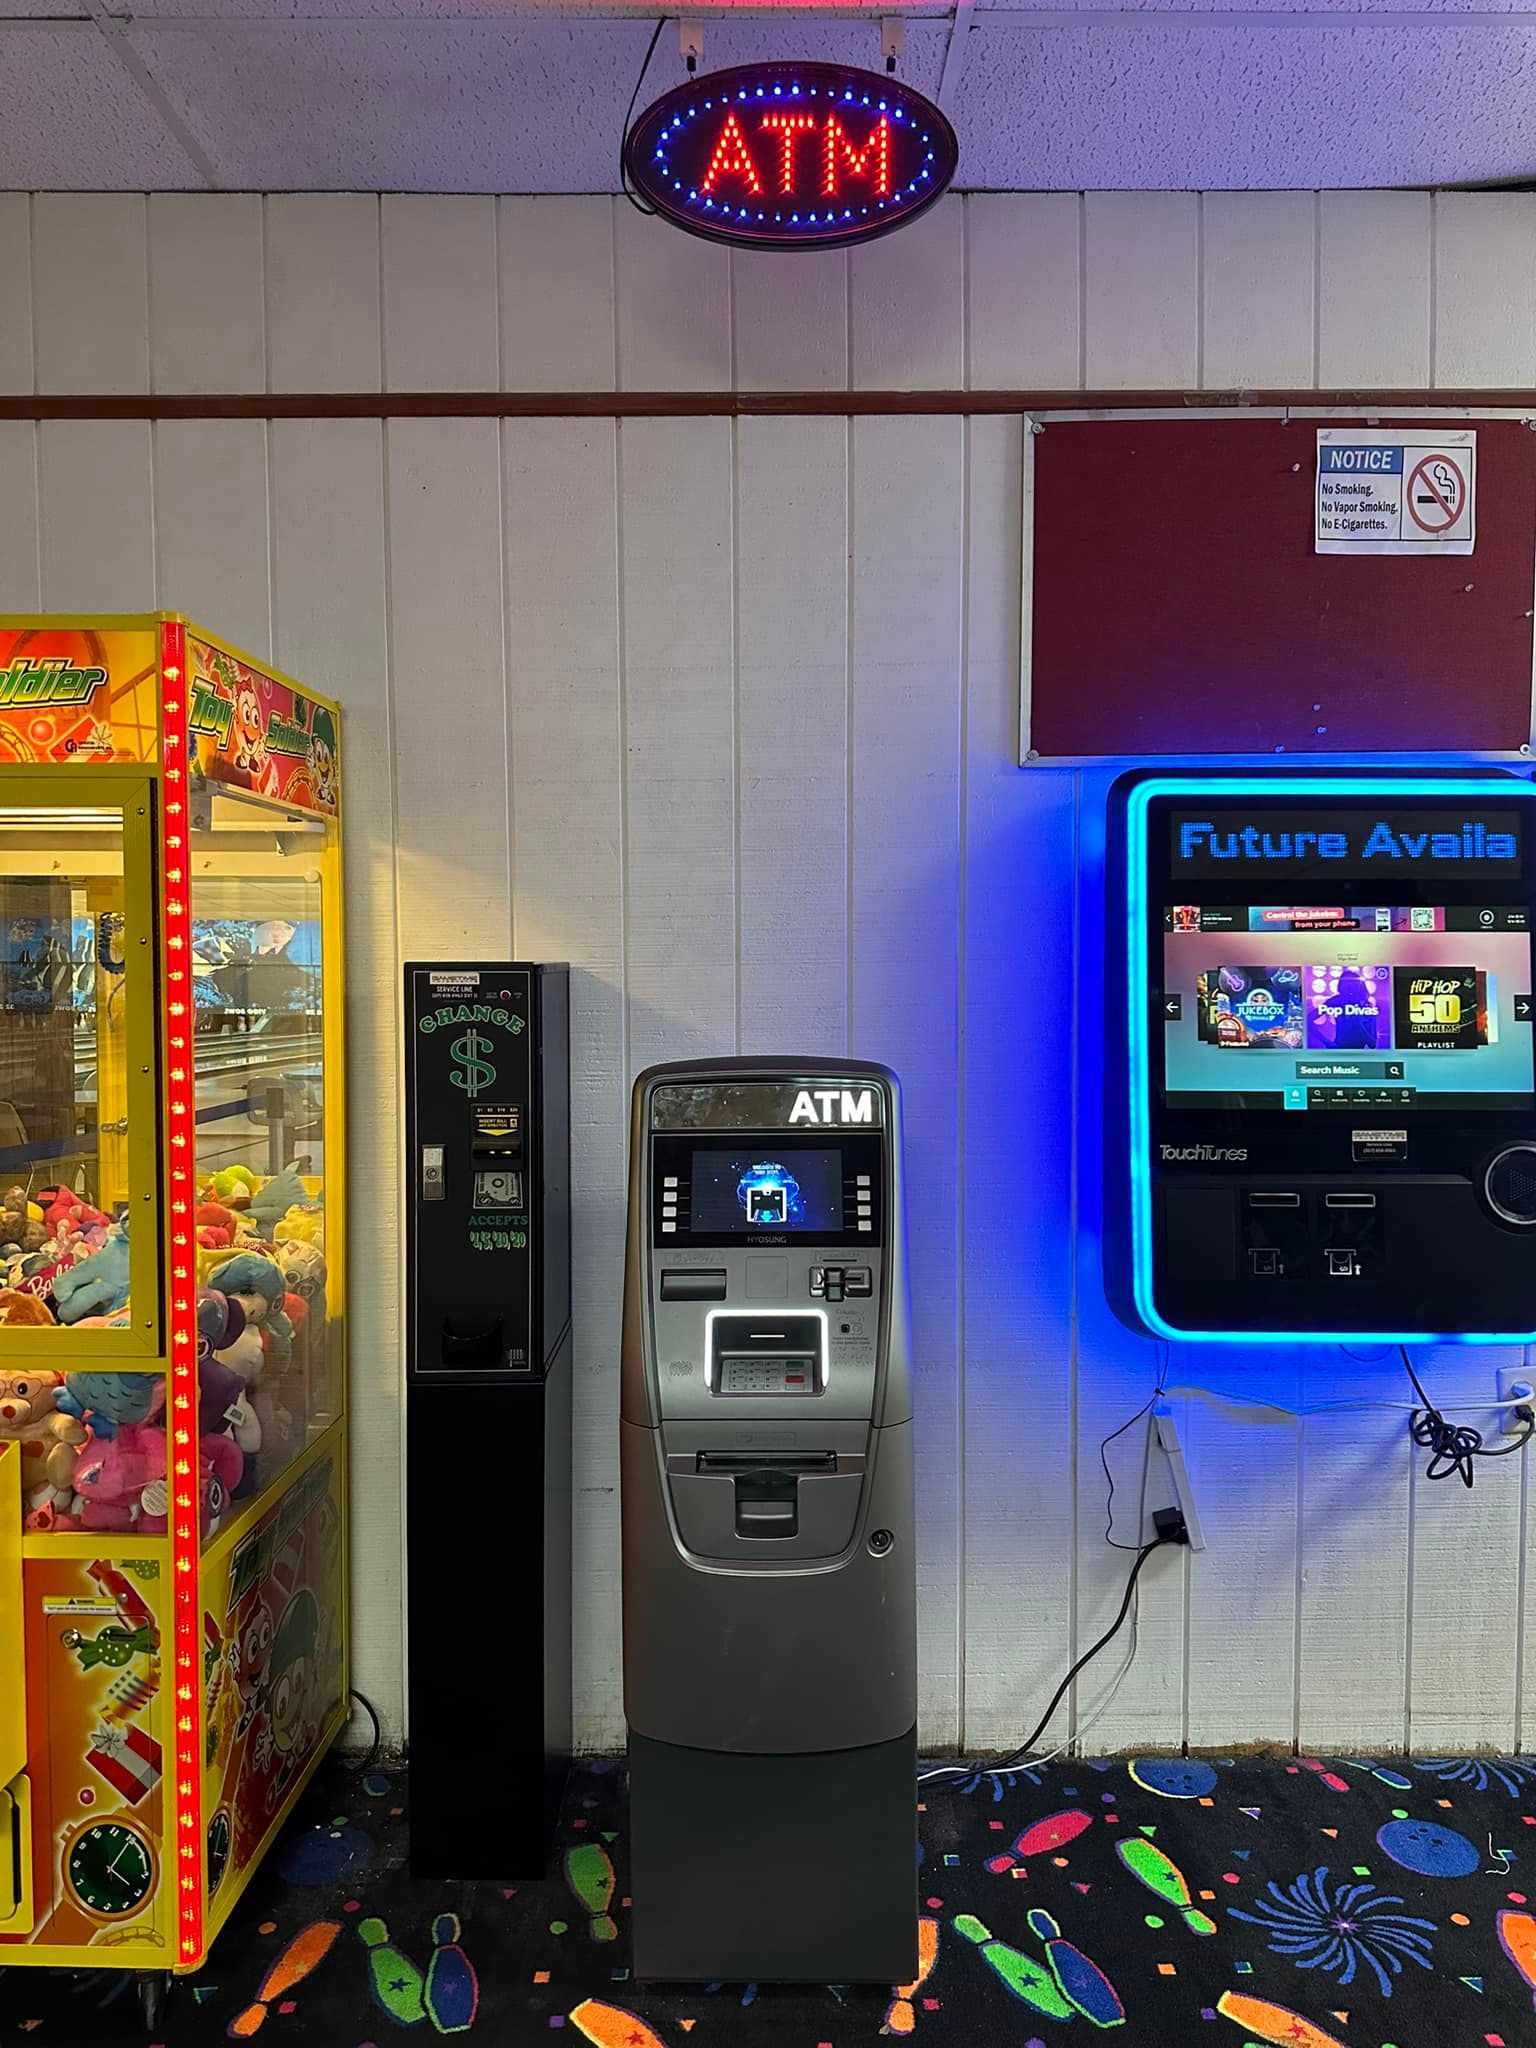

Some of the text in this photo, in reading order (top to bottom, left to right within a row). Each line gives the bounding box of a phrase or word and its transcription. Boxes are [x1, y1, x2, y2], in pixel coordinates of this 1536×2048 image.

[701, 113, 889, 194] ATM
[1330, 450, 1393, 469] NOTICE
[1321, 483, 1374, 497] No Smoking.
[1321, 501, 1399, 515] No Vapor Smoking.
[1321, 518, 1388, 531] No E-Cigarettes.
[189, 675, 235, 751] Toy
[1180, 821, 1518, 858] Future Availa
[1265, 910, 1339, 919] Control the jukebox
[1314, 921, 1331, 929] your
[1332, 920, 1356, 928] phone
[1432, 980, 1461, 995] HOP
[1236, 1006, 1285, 1017] JUKEBOX
[1318, 1003, 1379, 1017] Pop Divas
[1409, 994, 1461, 1023] 50
[419, 1004, 526, 1036] CHANGE
[1411, 1023, 1461, 1034] ANTHEMS
[1300, 1065, 1360, 1075] Search Music
[788, 1090, 873, 1123] ATM
[1159, 1143, 1248, 1161] TouchTunes
[468, 1215, 529, 1226] ACCEPTS
[747, 1236, 787, 1244] HYOSUNG
[90, 1828, 102, 1839] 10
[109, 1826, 120, 1837] 11
[87, 1895, 96, 1904] 6
